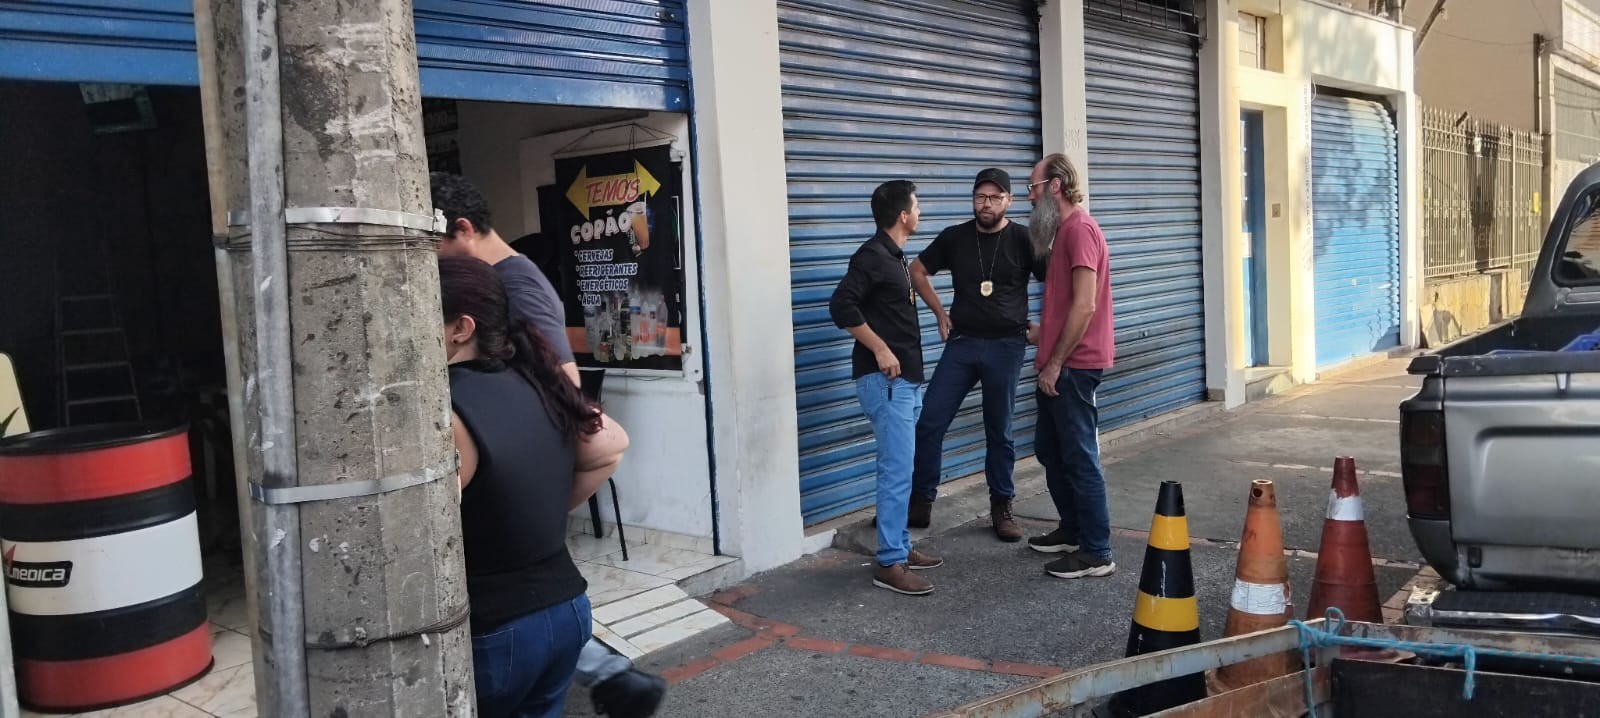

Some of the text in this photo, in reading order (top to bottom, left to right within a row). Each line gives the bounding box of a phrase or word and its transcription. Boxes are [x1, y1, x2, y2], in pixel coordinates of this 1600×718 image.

[585, 178, 640, 204] TEMOS
[570, 208, 632, 245] COPÃO
[578, 249, 614, 263] CERVEJAS
[579, 263, 638, 278] REFRIGERANTES
[580, 277, 629, 292] ENERGÉTICOS
[581, 293, 602, 307] ÁGUA
